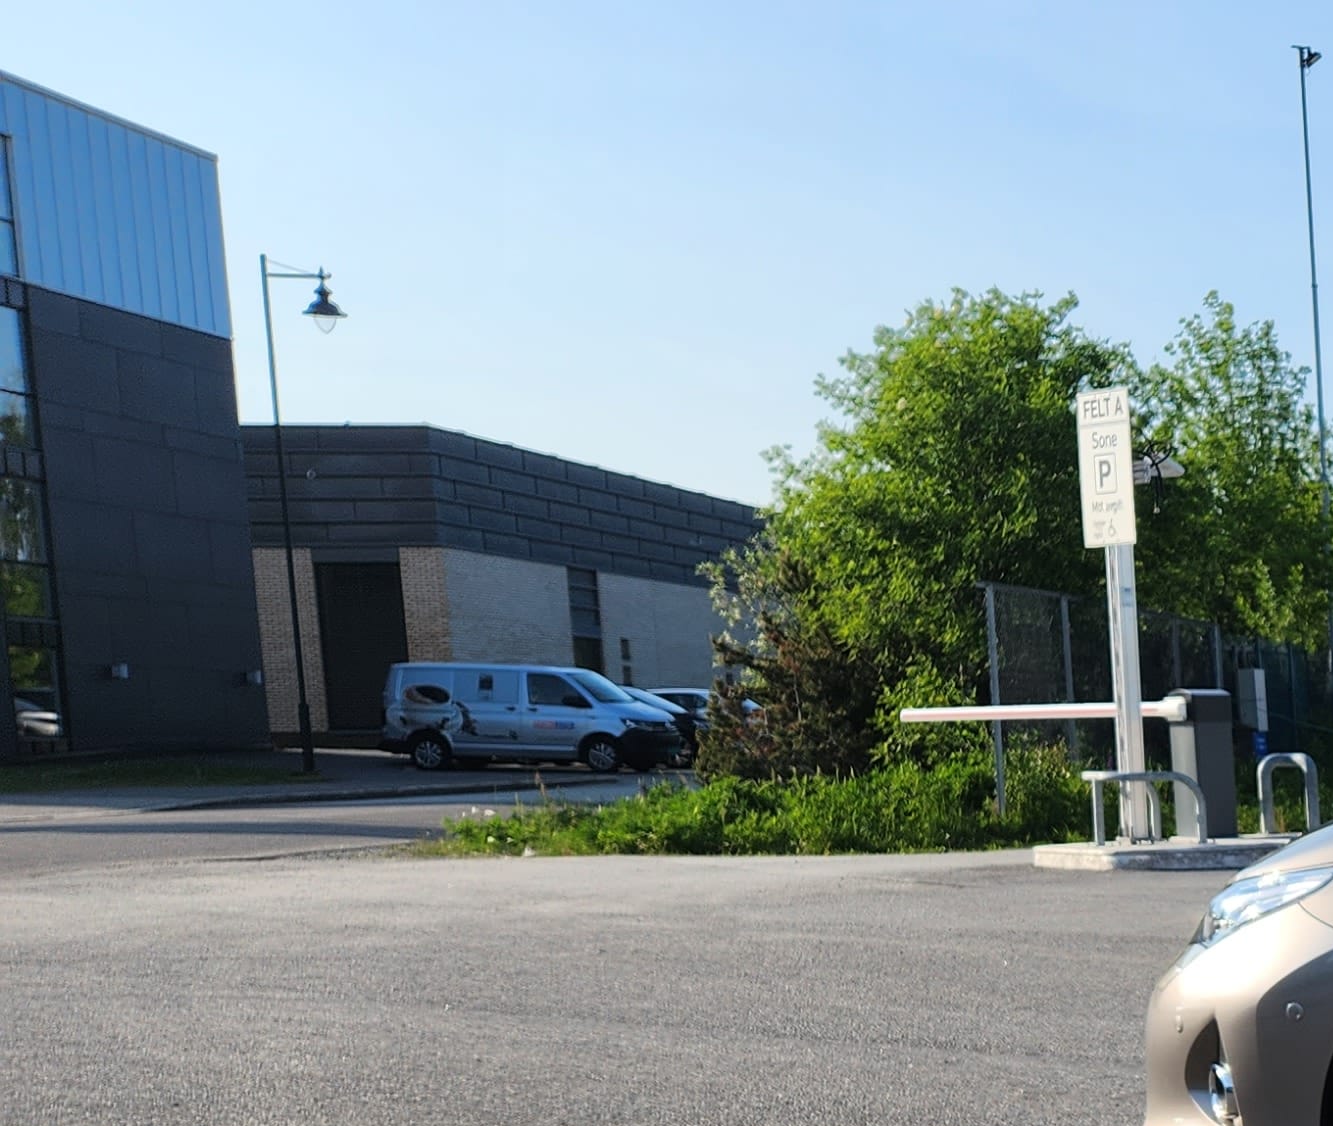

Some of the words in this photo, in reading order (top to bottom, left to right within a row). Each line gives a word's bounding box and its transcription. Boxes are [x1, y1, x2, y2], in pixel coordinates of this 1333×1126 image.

[1083, 397, 1111, 420] FELT
[1114, 395, 1124, 416] A
[1091, 431, 1118, 450] Sone
[1098, 459, 1112, 489] P
